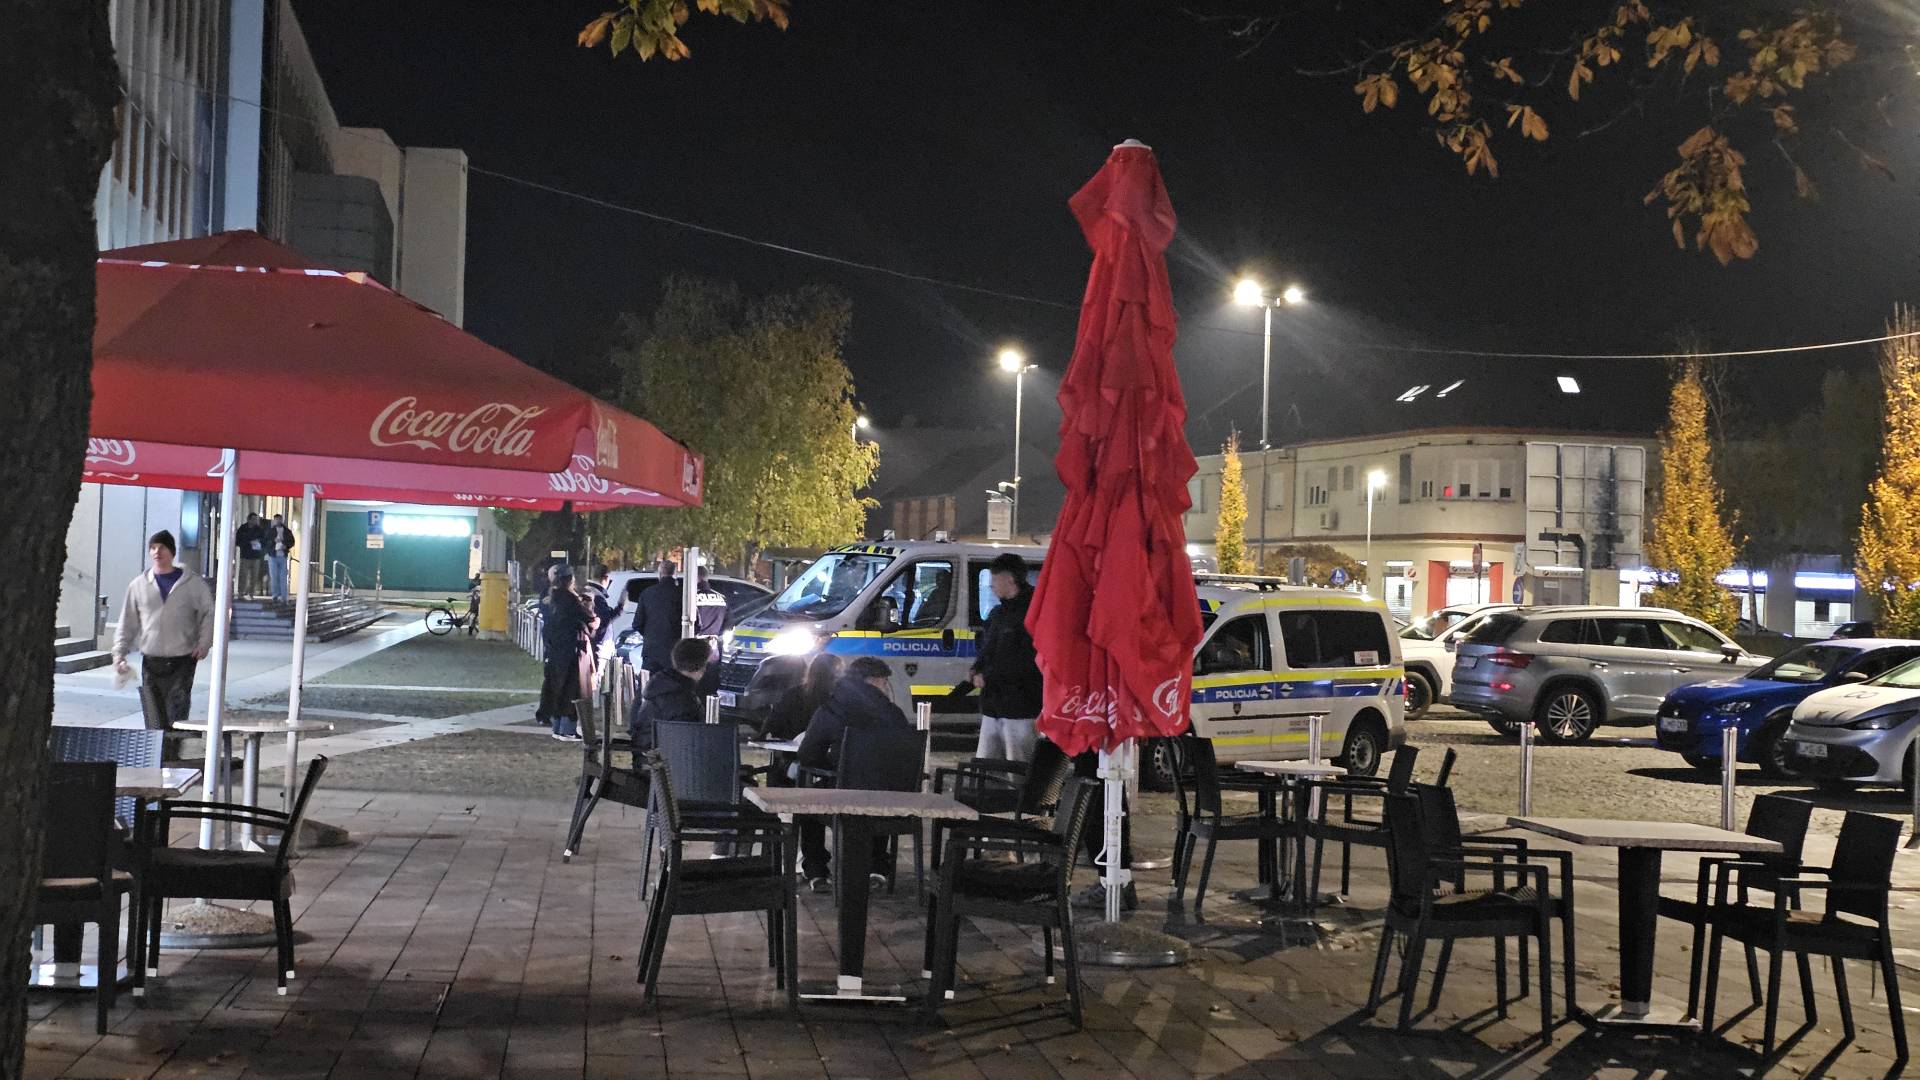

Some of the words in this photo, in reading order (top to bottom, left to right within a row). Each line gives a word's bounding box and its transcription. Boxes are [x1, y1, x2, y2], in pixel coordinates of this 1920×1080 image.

[370, 396, 548, 456] Coca-Cola
[883, 643, 940, 652] POLICIJA
[1215, 689, 1258, 699] POLICIJA
